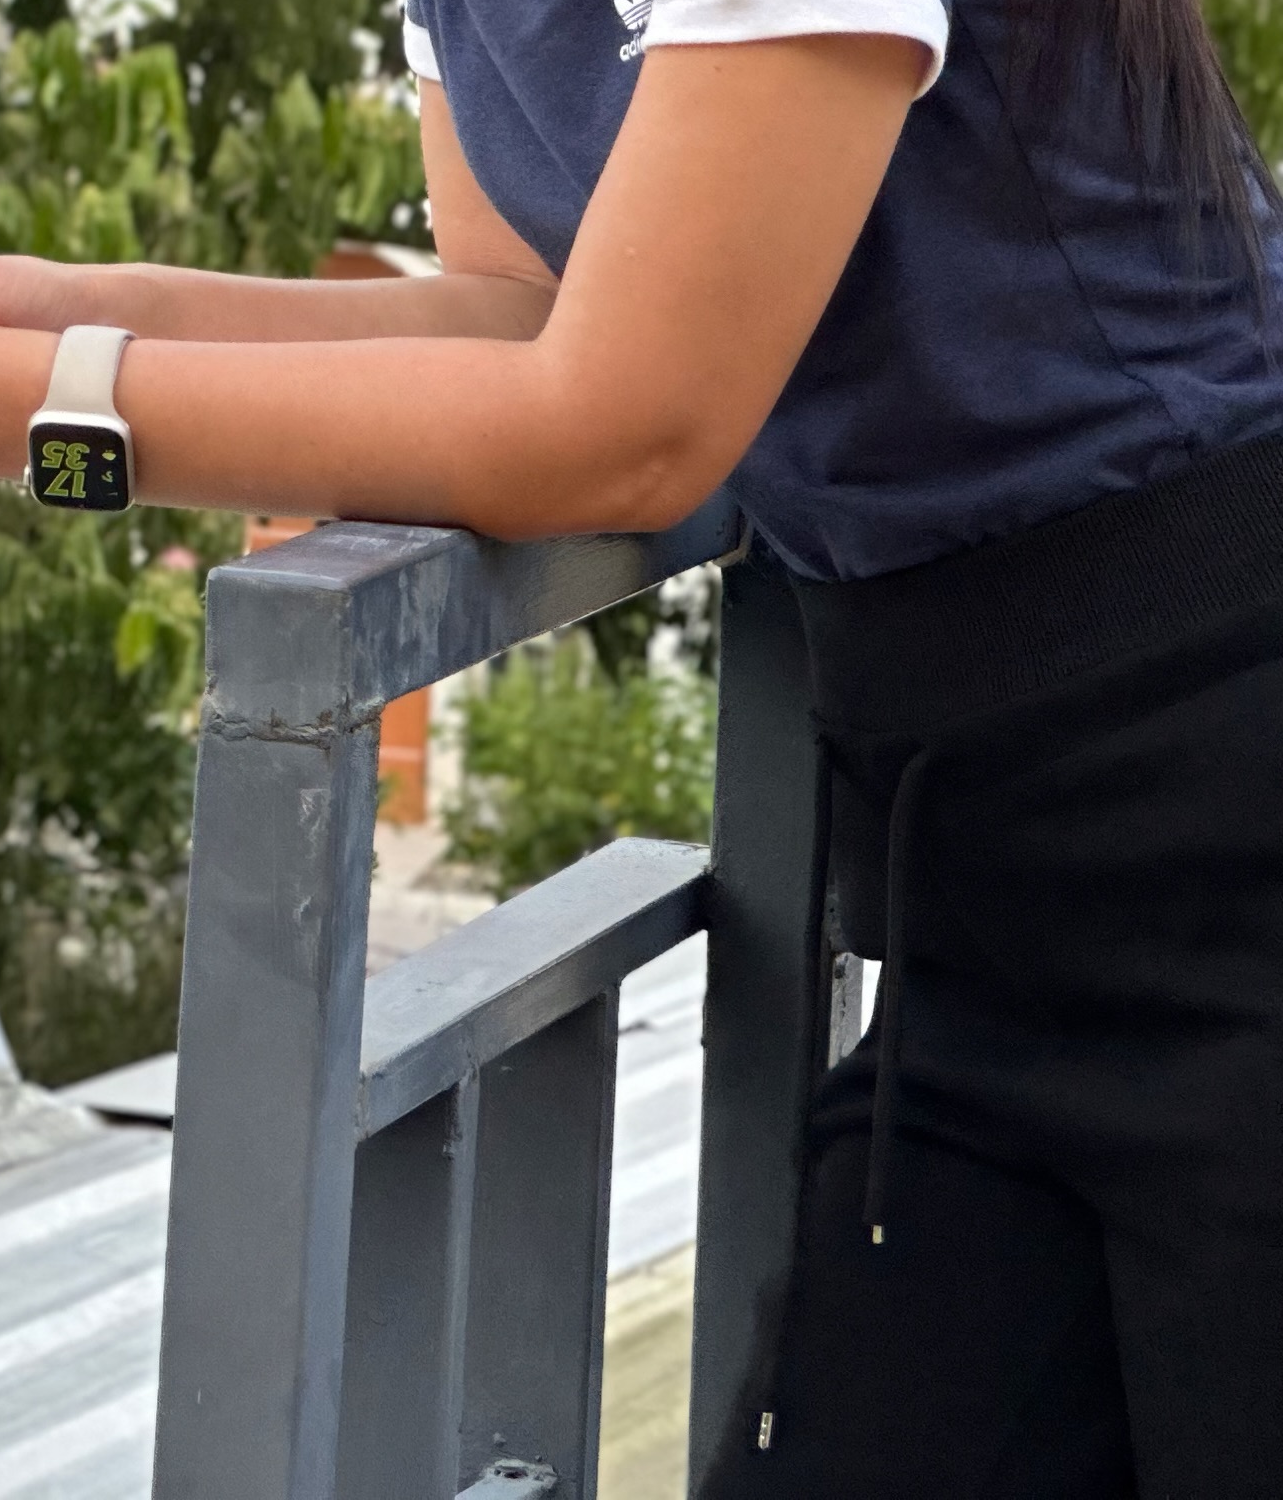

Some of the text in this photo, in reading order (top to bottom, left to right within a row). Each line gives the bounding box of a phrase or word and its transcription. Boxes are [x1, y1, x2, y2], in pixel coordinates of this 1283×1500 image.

[619, 31, 643, 62] adi
[41, 440, 90, 470] 35
[44, 470, 87, 498] 17
